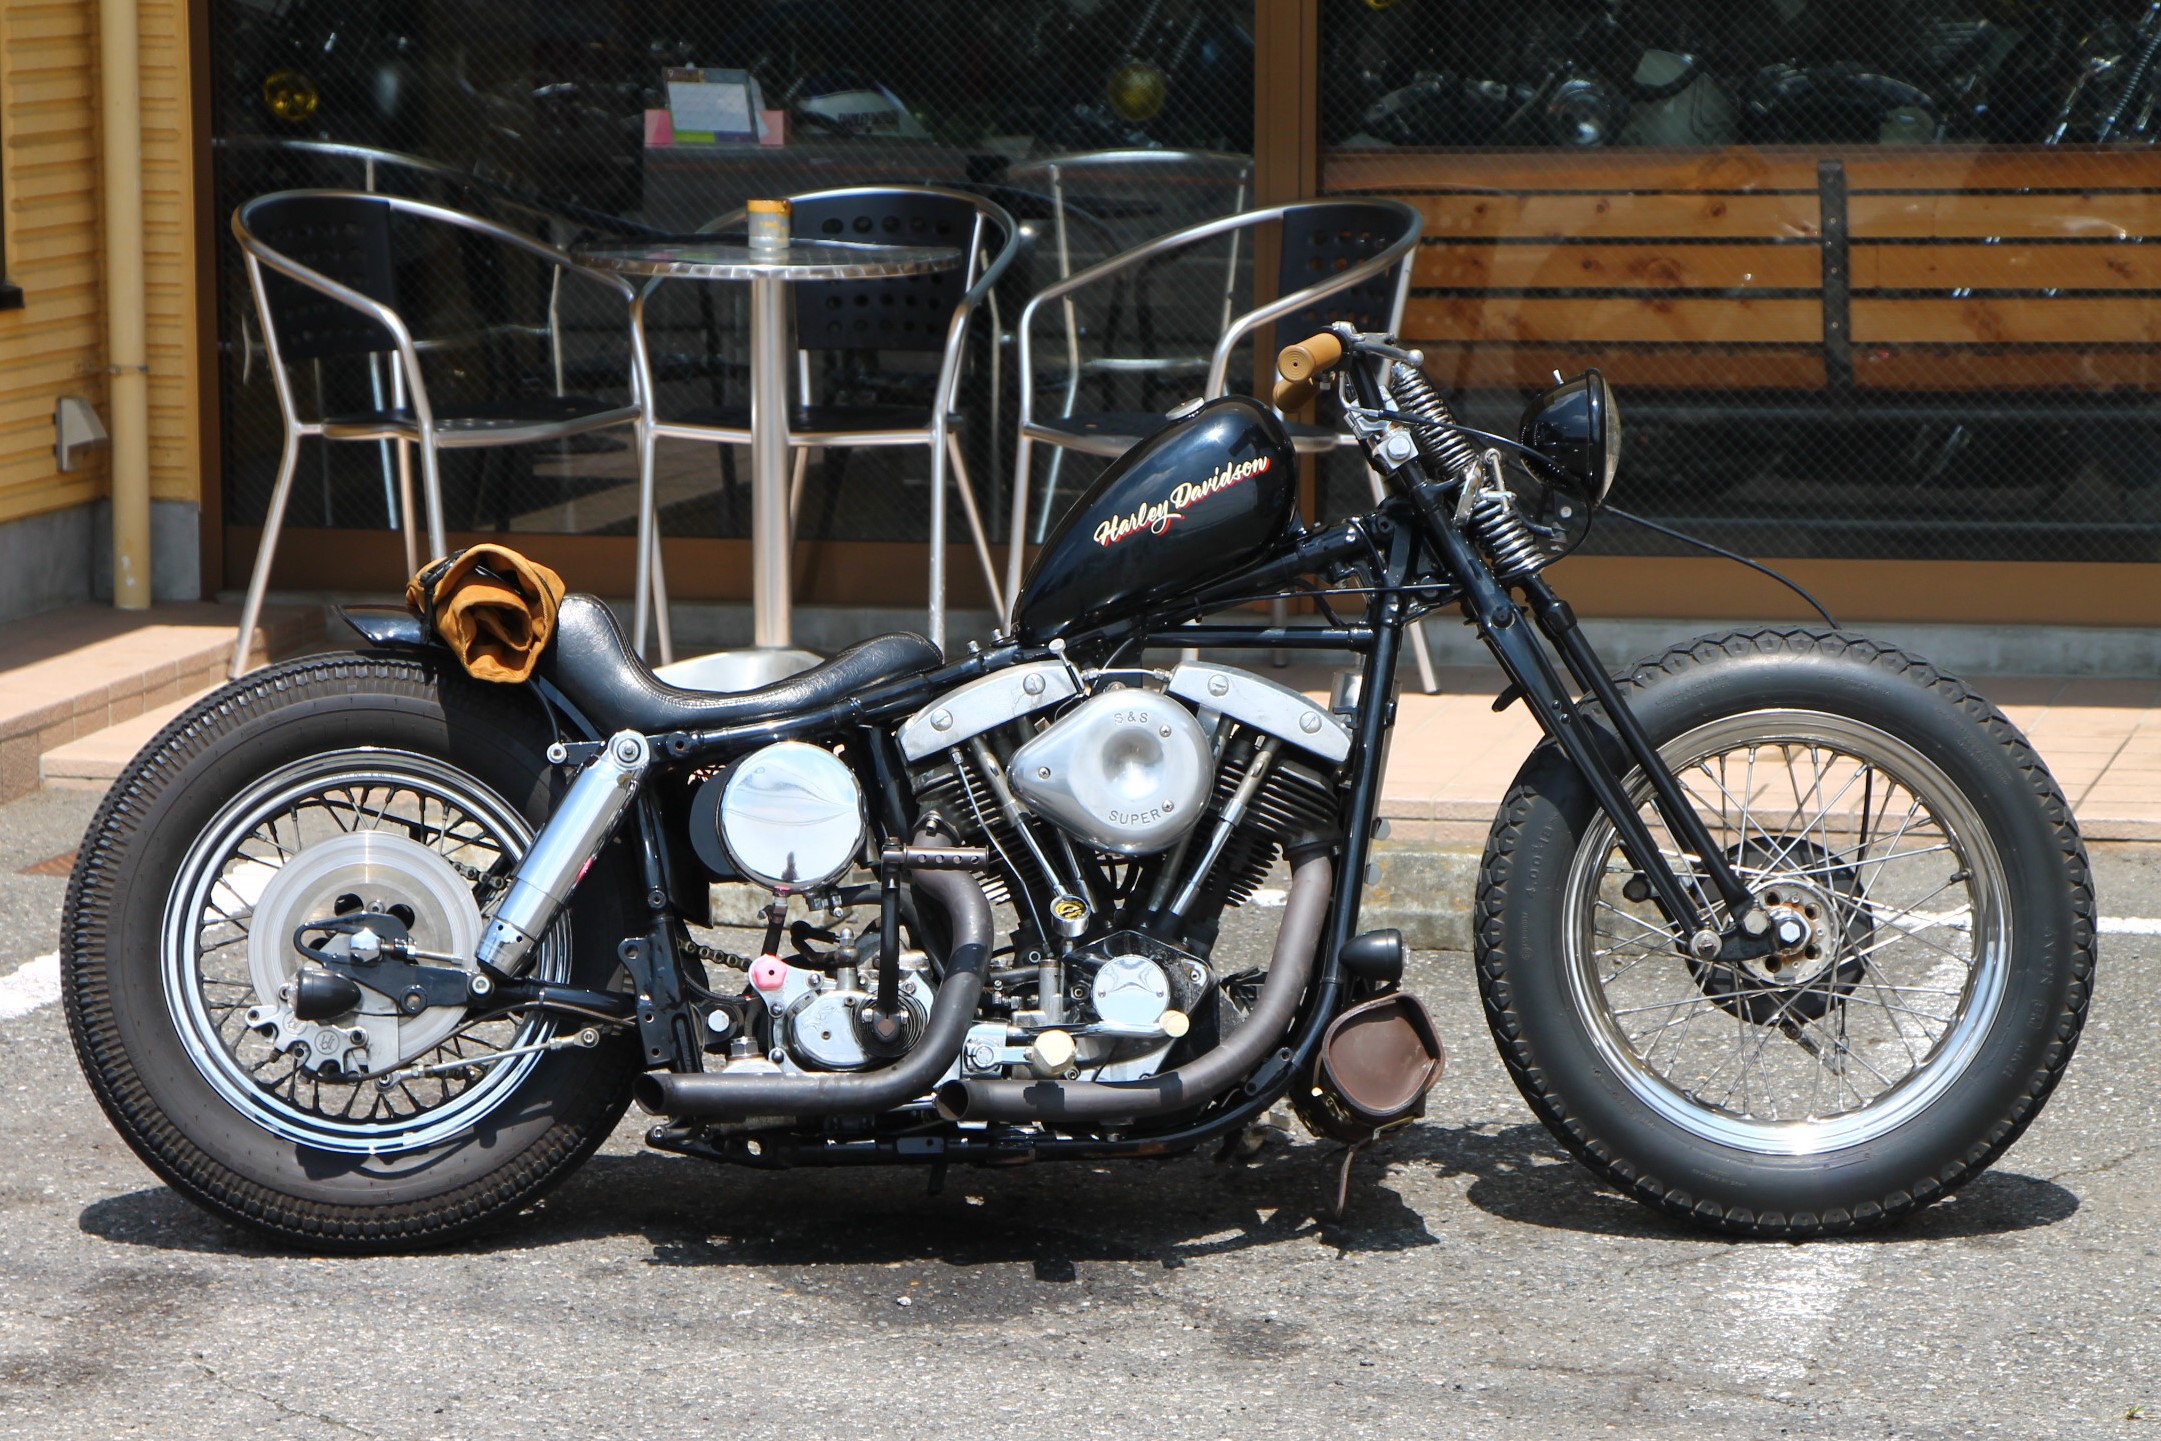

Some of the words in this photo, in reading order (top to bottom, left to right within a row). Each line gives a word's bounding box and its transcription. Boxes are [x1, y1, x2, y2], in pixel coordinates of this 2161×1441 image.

[1093, 500, 1184, 546] Harley
[1170, 456, 1271, 509] Davidson
[1108, 808, 1161, 825] SUPER
